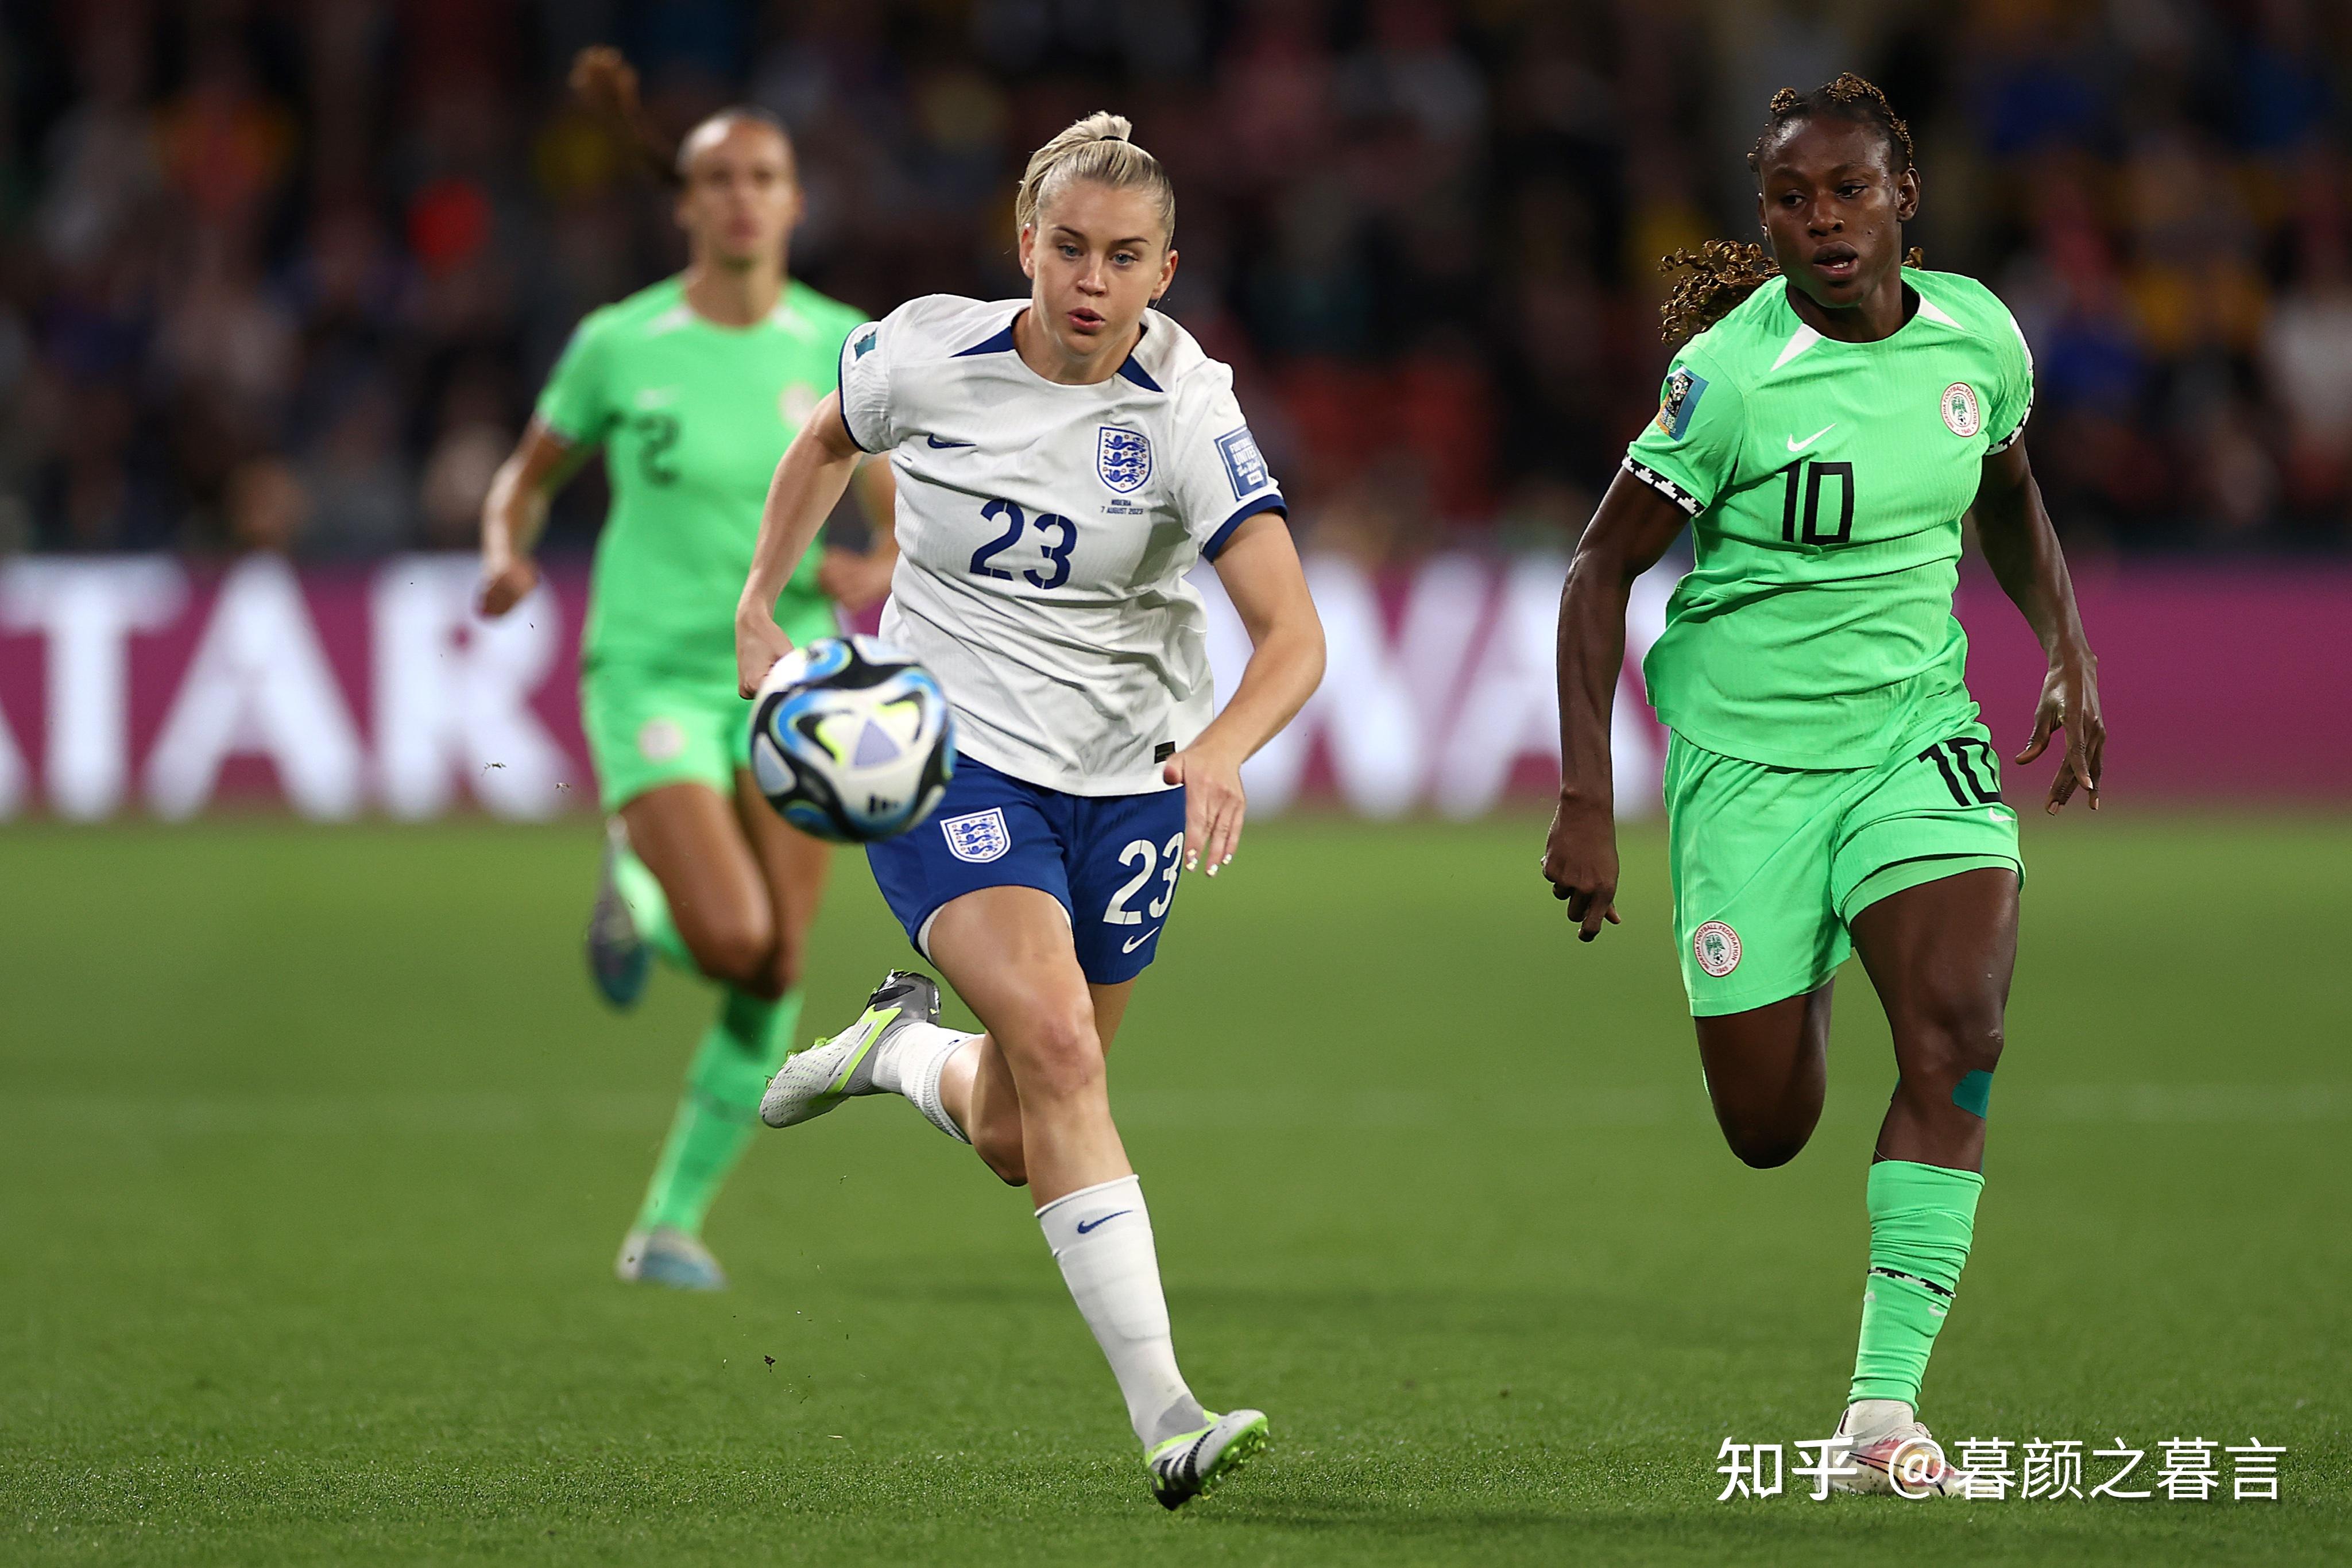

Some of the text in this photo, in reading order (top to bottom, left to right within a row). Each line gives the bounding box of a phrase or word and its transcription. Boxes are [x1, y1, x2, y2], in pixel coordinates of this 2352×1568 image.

[635, 413, 680, 487] 2
[970, 498, 1078, 590] 23
[1777, 460, 1855, 545] 10
[0, 554, 577, 821] TAR
[1917, 737, 2003, 807] 10
[1103, 832, 1184, 925] 23
[1696, 924, 1717, 944] FOOTBALL
[1719, 926, 1739, 961] FEDERATION
